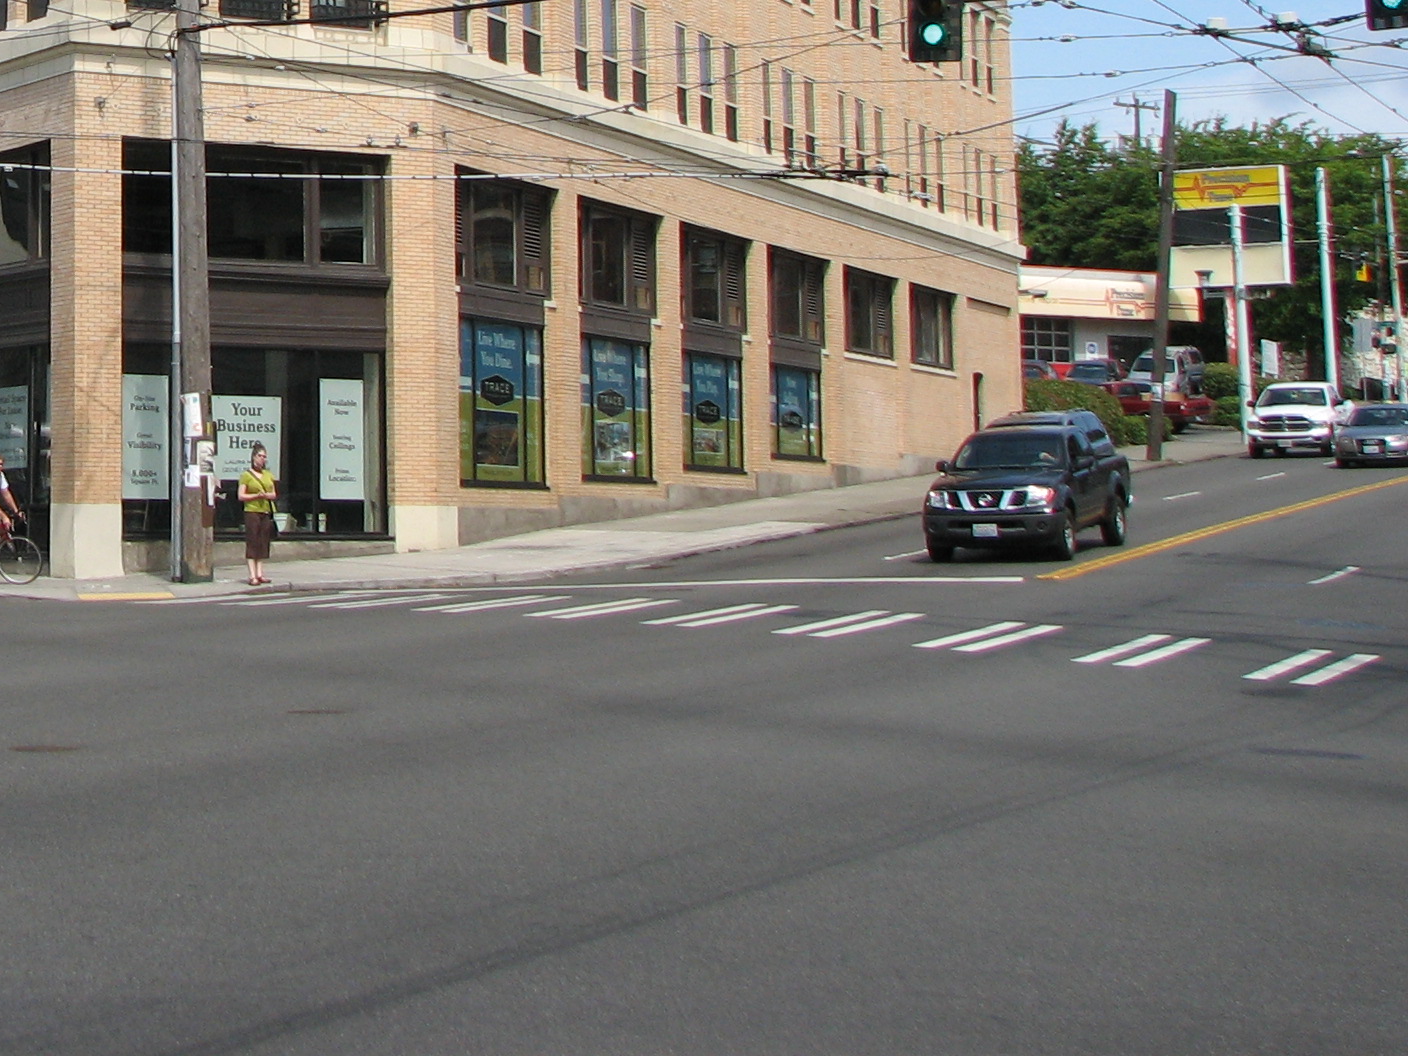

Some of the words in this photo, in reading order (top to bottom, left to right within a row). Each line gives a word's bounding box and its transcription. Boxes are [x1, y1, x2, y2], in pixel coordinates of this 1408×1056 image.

[484, 381, 510, 394] TRACE
[600, 394, 623, 406] TRACE
[130, 403, 160, 414] Parking
[231, 402, 263, 417] Your
[217, 418, 276, 433] Business
